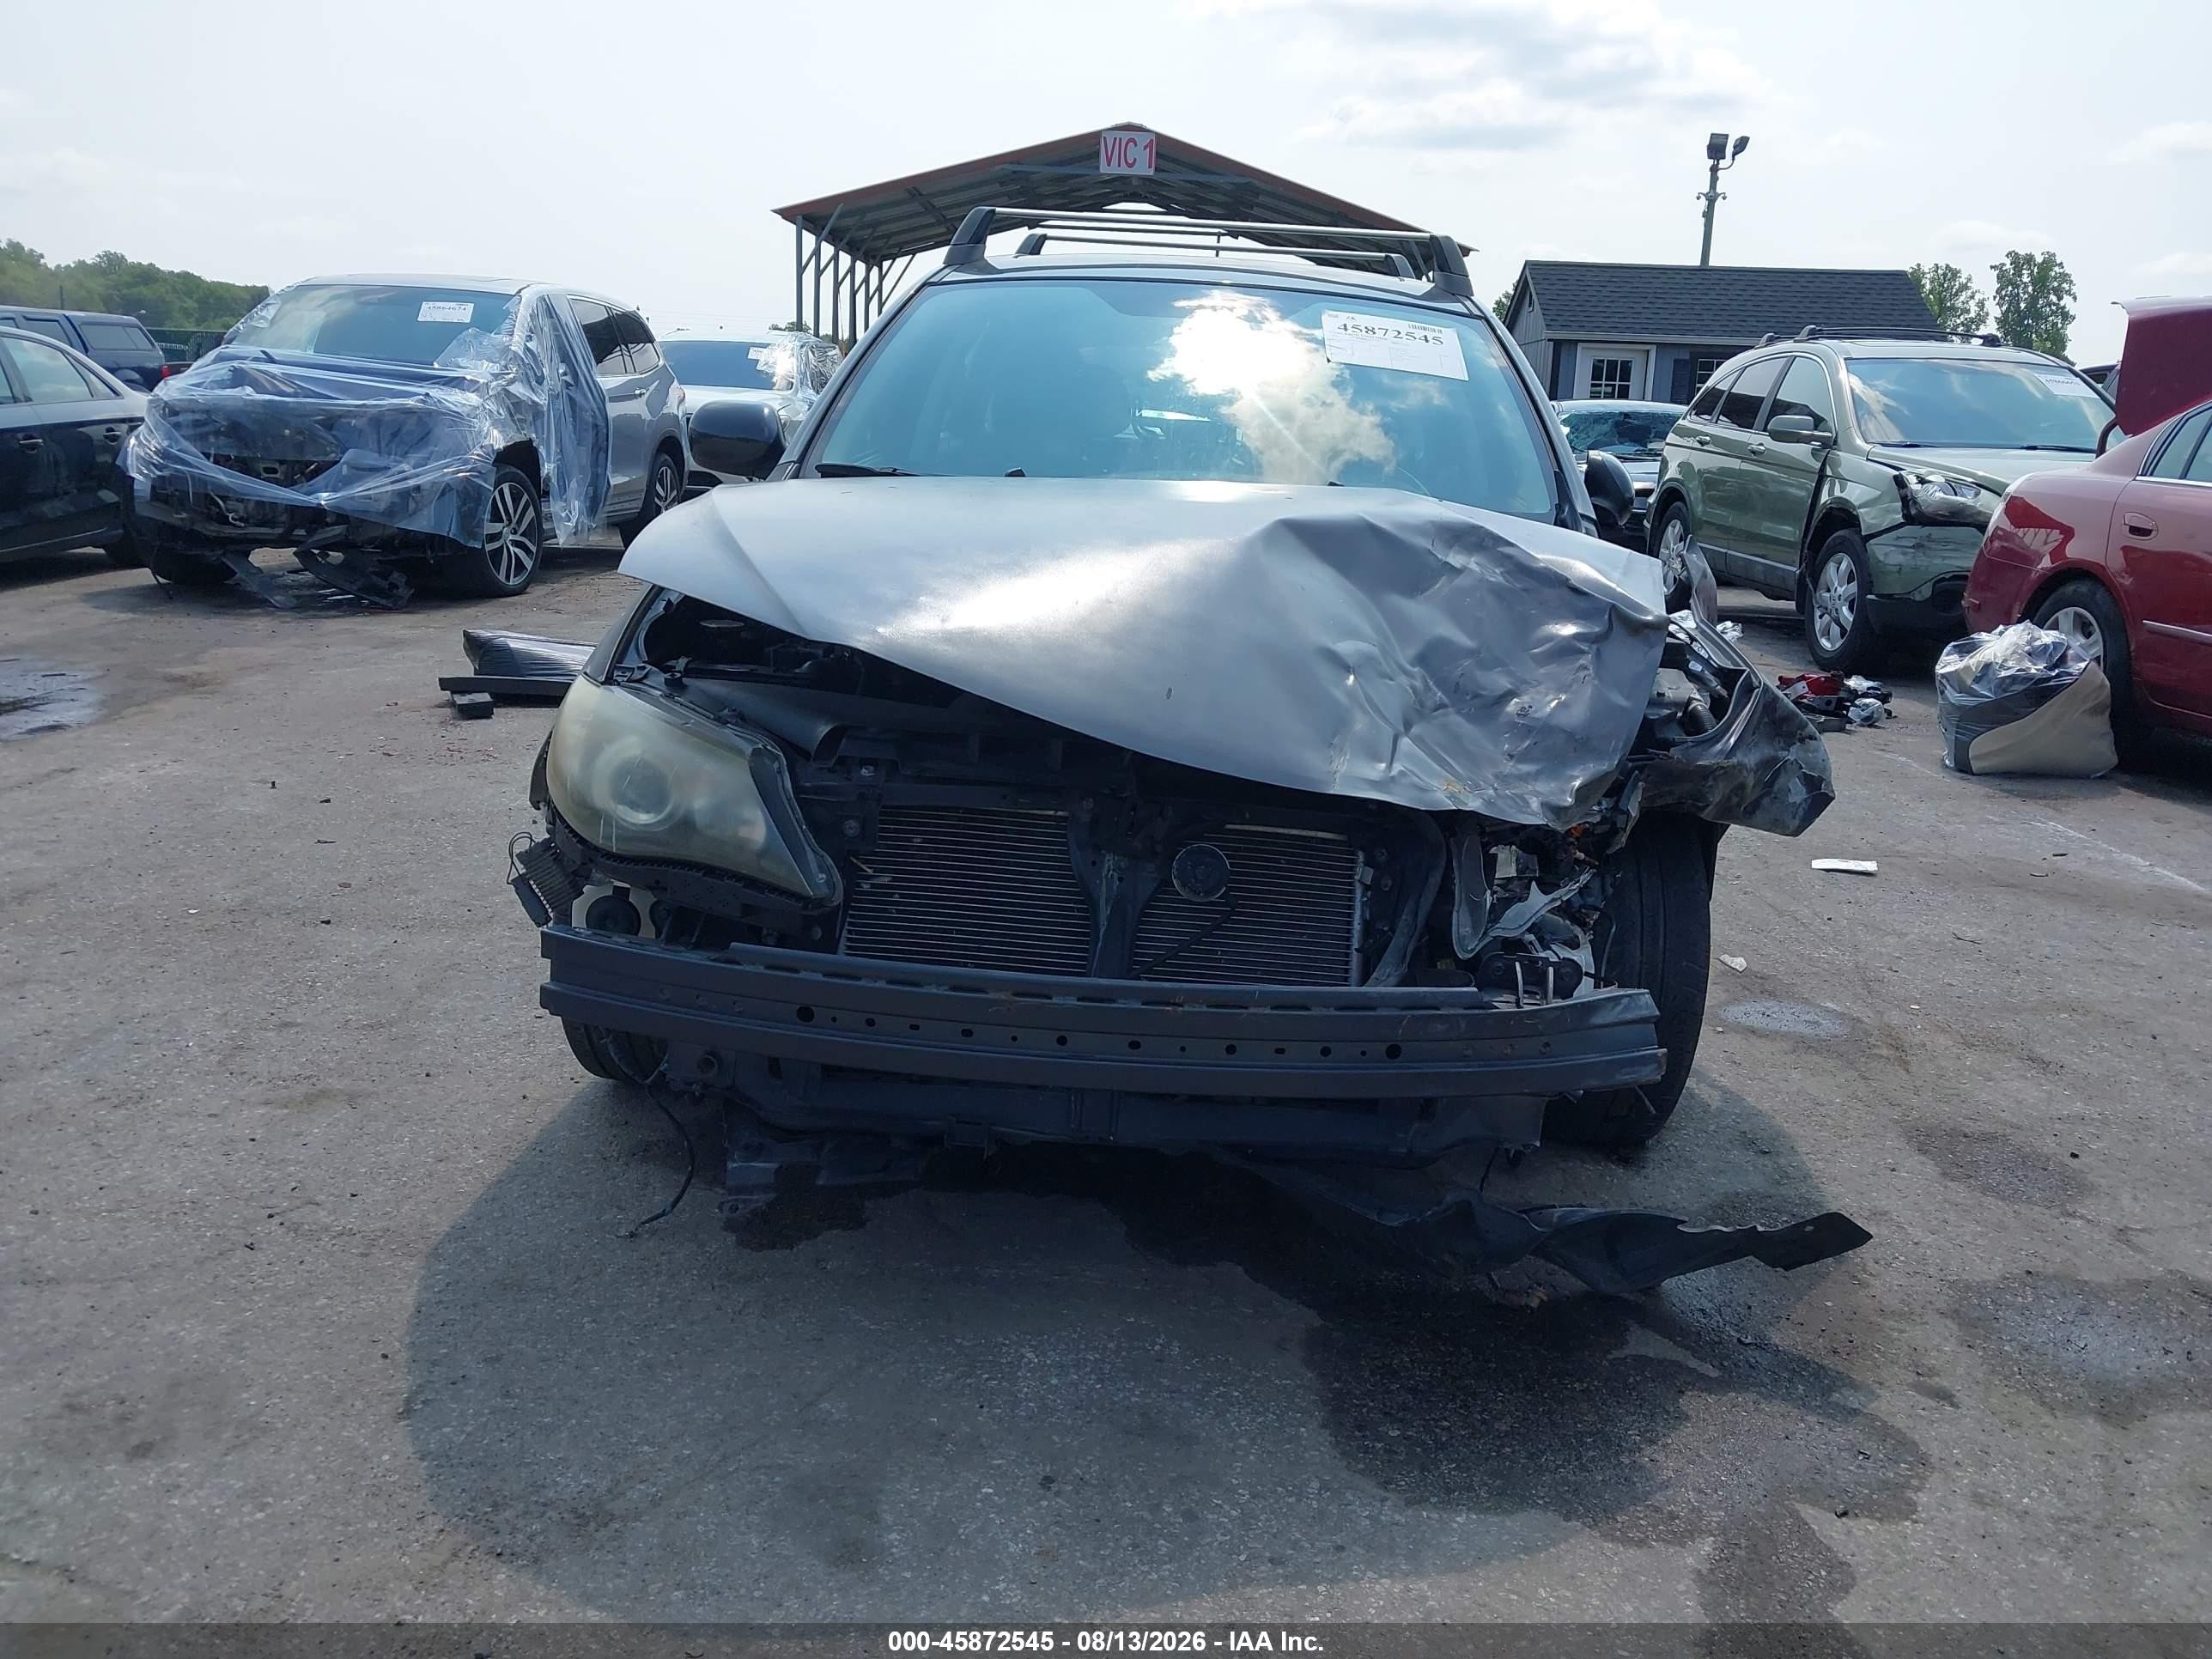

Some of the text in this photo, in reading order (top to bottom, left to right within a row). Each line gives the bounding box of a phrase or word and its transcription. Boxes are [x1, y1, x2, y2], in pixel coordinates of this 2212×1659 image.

[1103, 137, 1154, 169] VIC 1
[1337, 322, 1444, 345] 45872545
